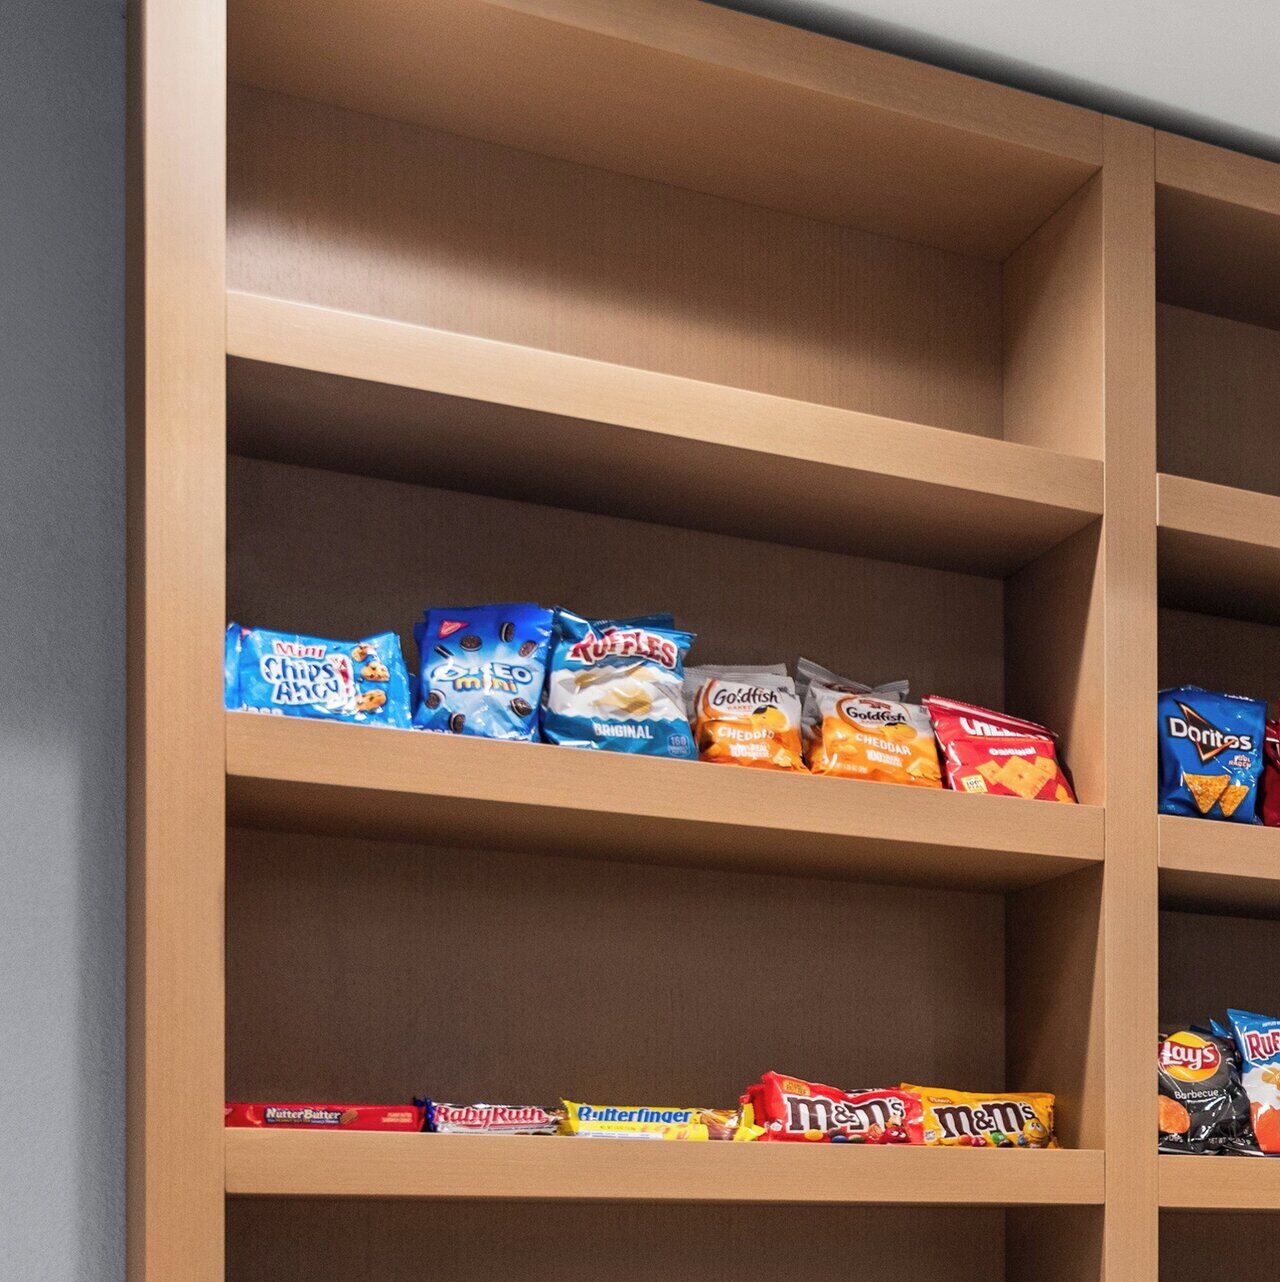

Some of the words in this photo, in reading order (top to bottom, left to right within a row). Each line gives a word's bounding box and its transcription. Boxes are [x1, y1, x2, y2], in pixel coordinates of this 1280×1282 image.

[566, 627, 678, 669] RUFFLES
[263, 656, 335, 683] Chips
[713, 687, 779, 706] Goldfish
[845, 706, 906, 722] Goldfish
[594, 721, 654, 740] ORIGINAL
[1168, 716, 1252, 750] Doritos
[855, 733, 912, 756] CHEDDAR
[1174, 1088, 1220, 1100] Barbecue
[266, 1106, 301, 1119] Nutter
[303, 1108, 342, 1121] Butter
[577, 1105, 694, 1123] Butterfinger
[932, 1101, 1037, 1139] m&m's
